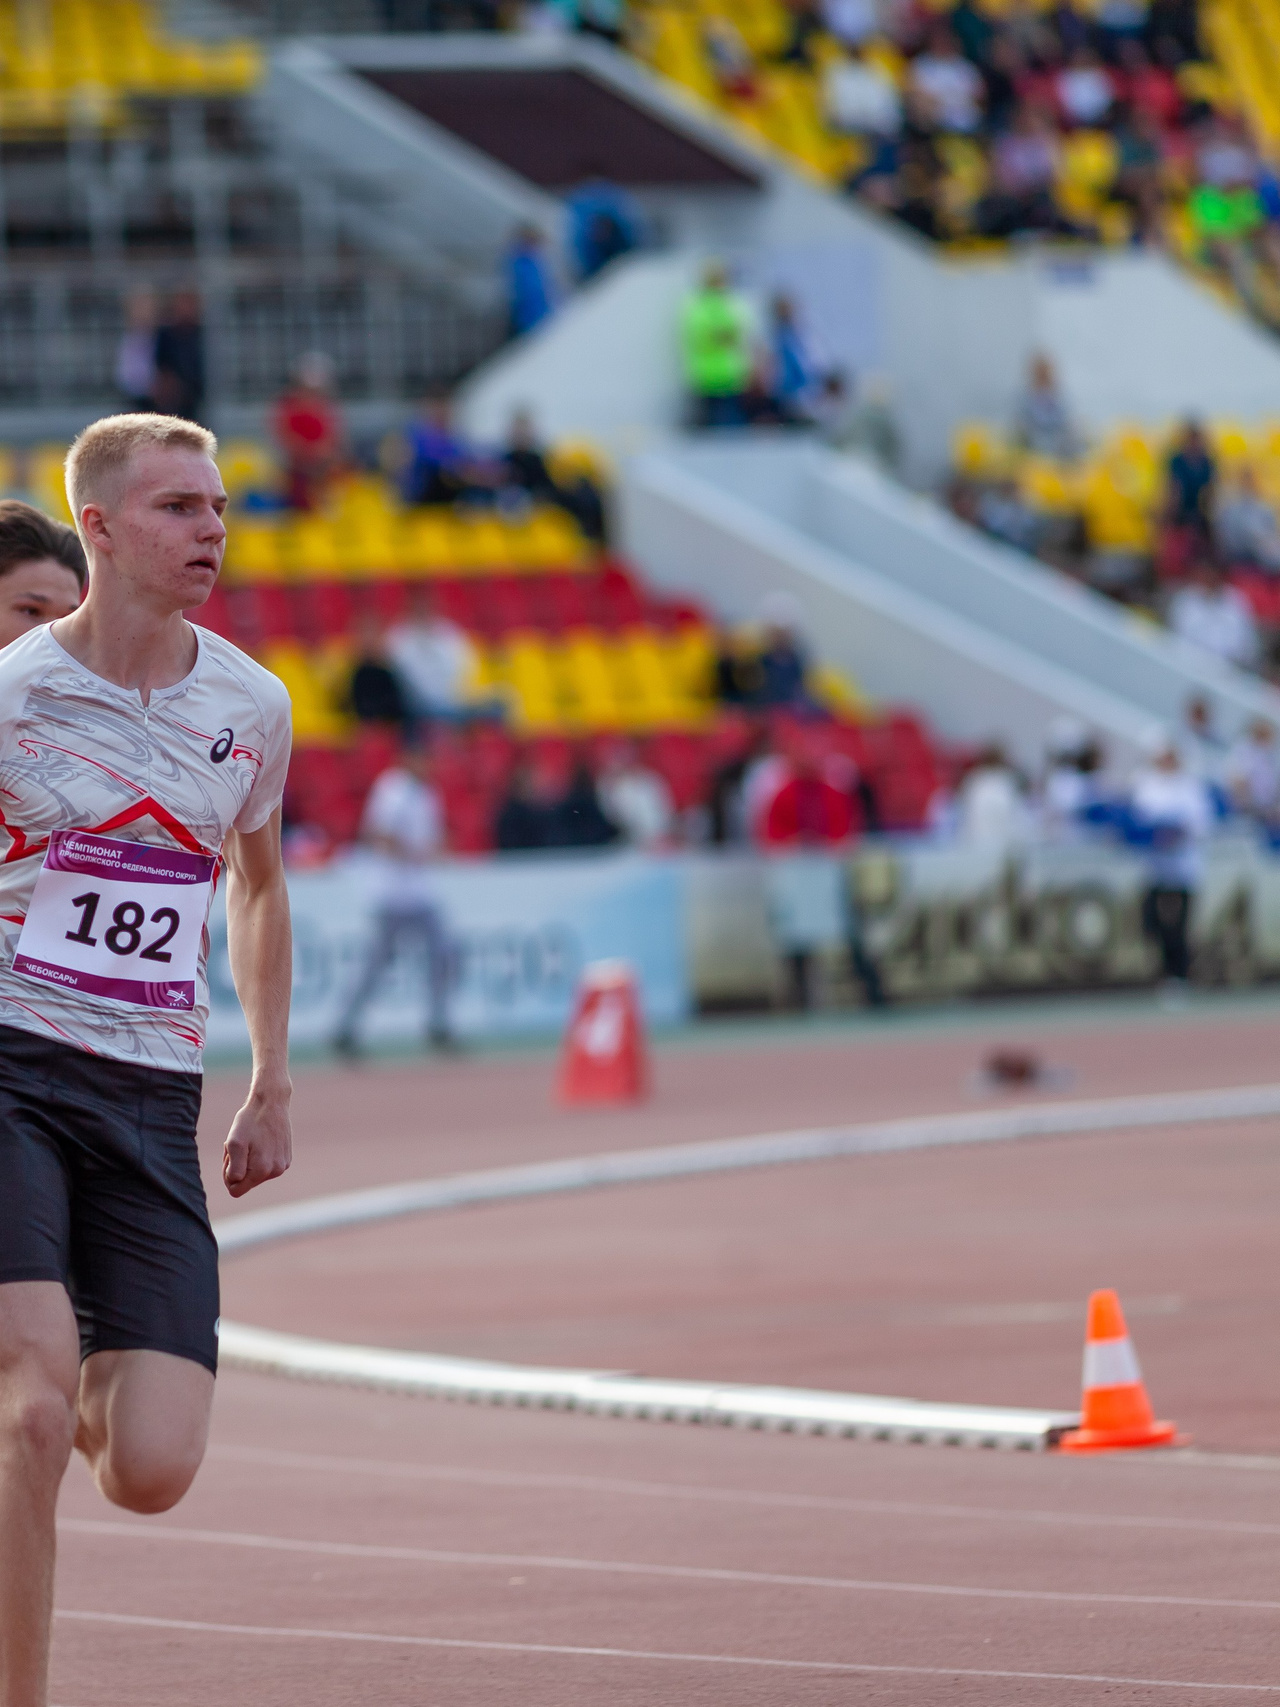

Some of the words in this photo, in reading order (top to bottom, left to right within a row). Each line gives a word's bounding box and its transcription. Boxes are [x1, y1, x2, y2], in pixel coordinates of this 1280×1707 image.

[62, 839, 123, 860] ЧЕМПИОНАТ
[59, 850, 121, 869] ПРИВОЛЖСКОГО
[121, 862, 175, 878] ФЕДЕРАЛЬНОГО
[175, 871, 197, 882] ОКРУГА
[65, 891, 180, 964] 182
[25, 963, 78, 985] ЧЕБОКСАРЫ
